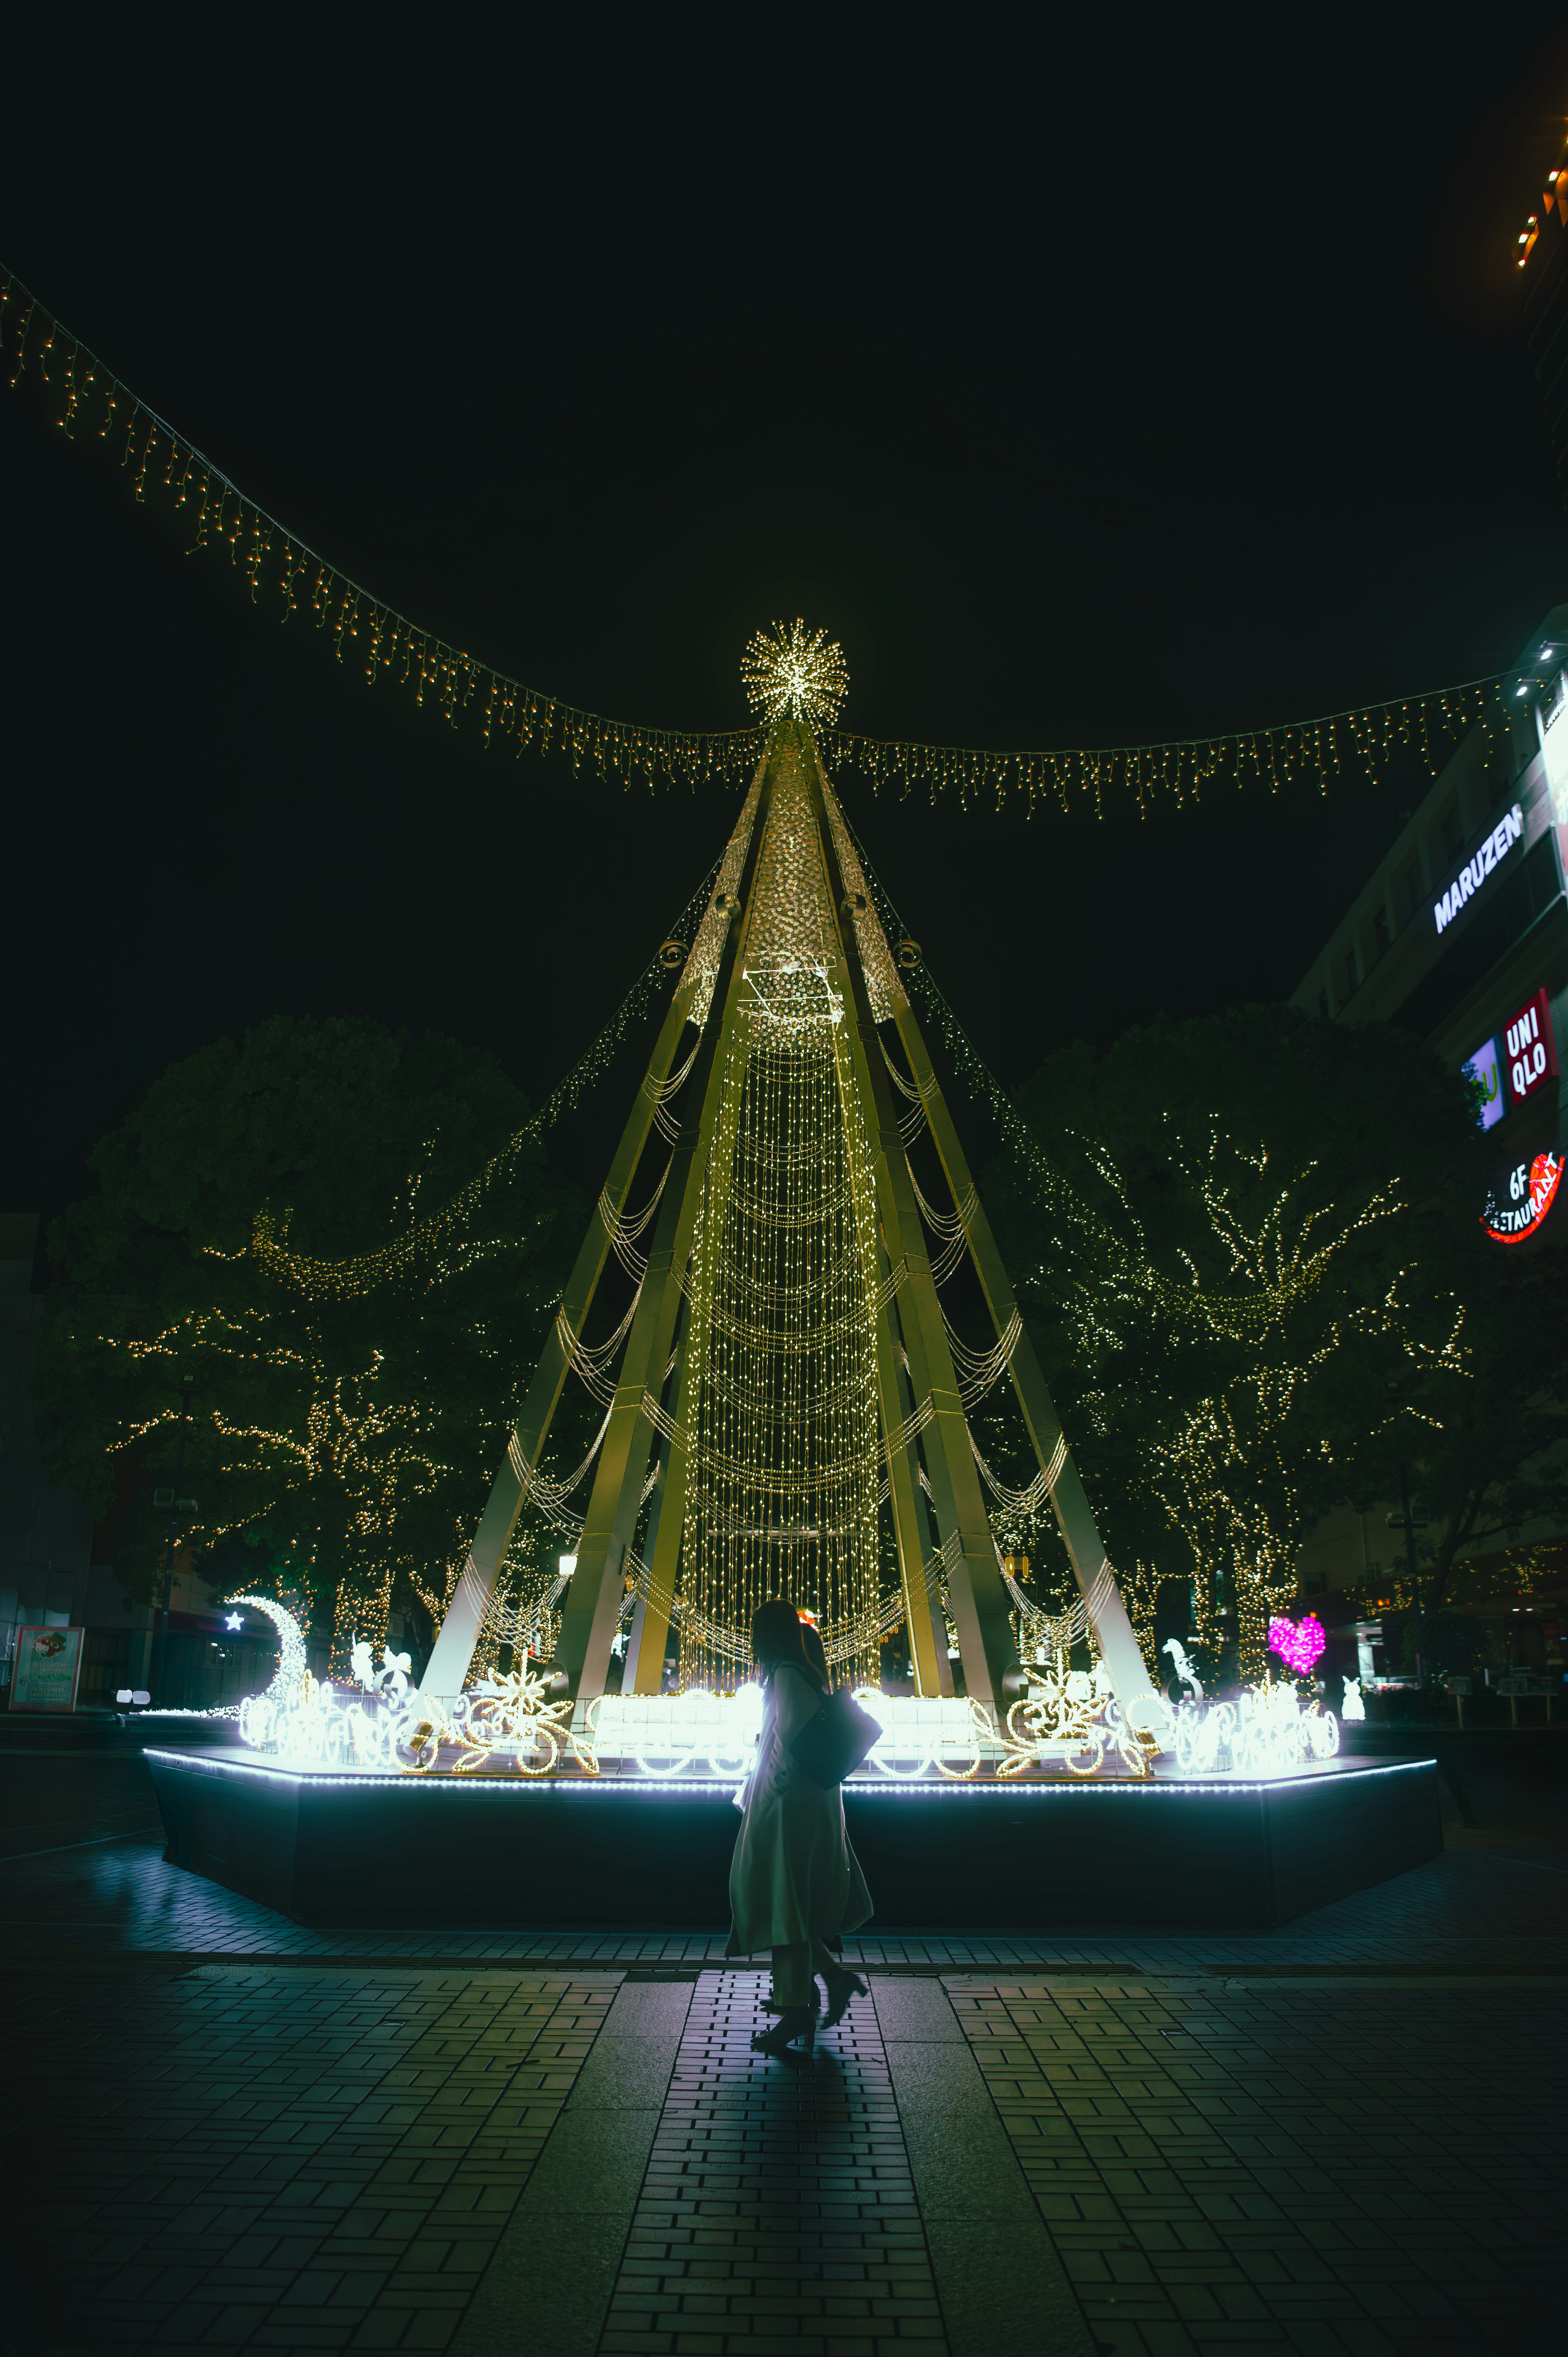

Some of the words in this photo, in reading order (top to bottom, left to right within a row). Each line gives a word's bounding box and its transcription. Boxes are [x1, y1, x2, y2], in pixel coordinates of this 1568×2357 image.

[1434, 803, 1521, 934] MARUZEN
[1507, 1007, 1539, 1057] UNI
[1512, 1042, 1546, 1095] QLO
[1510, 1164, 1526, 1200] 6F
